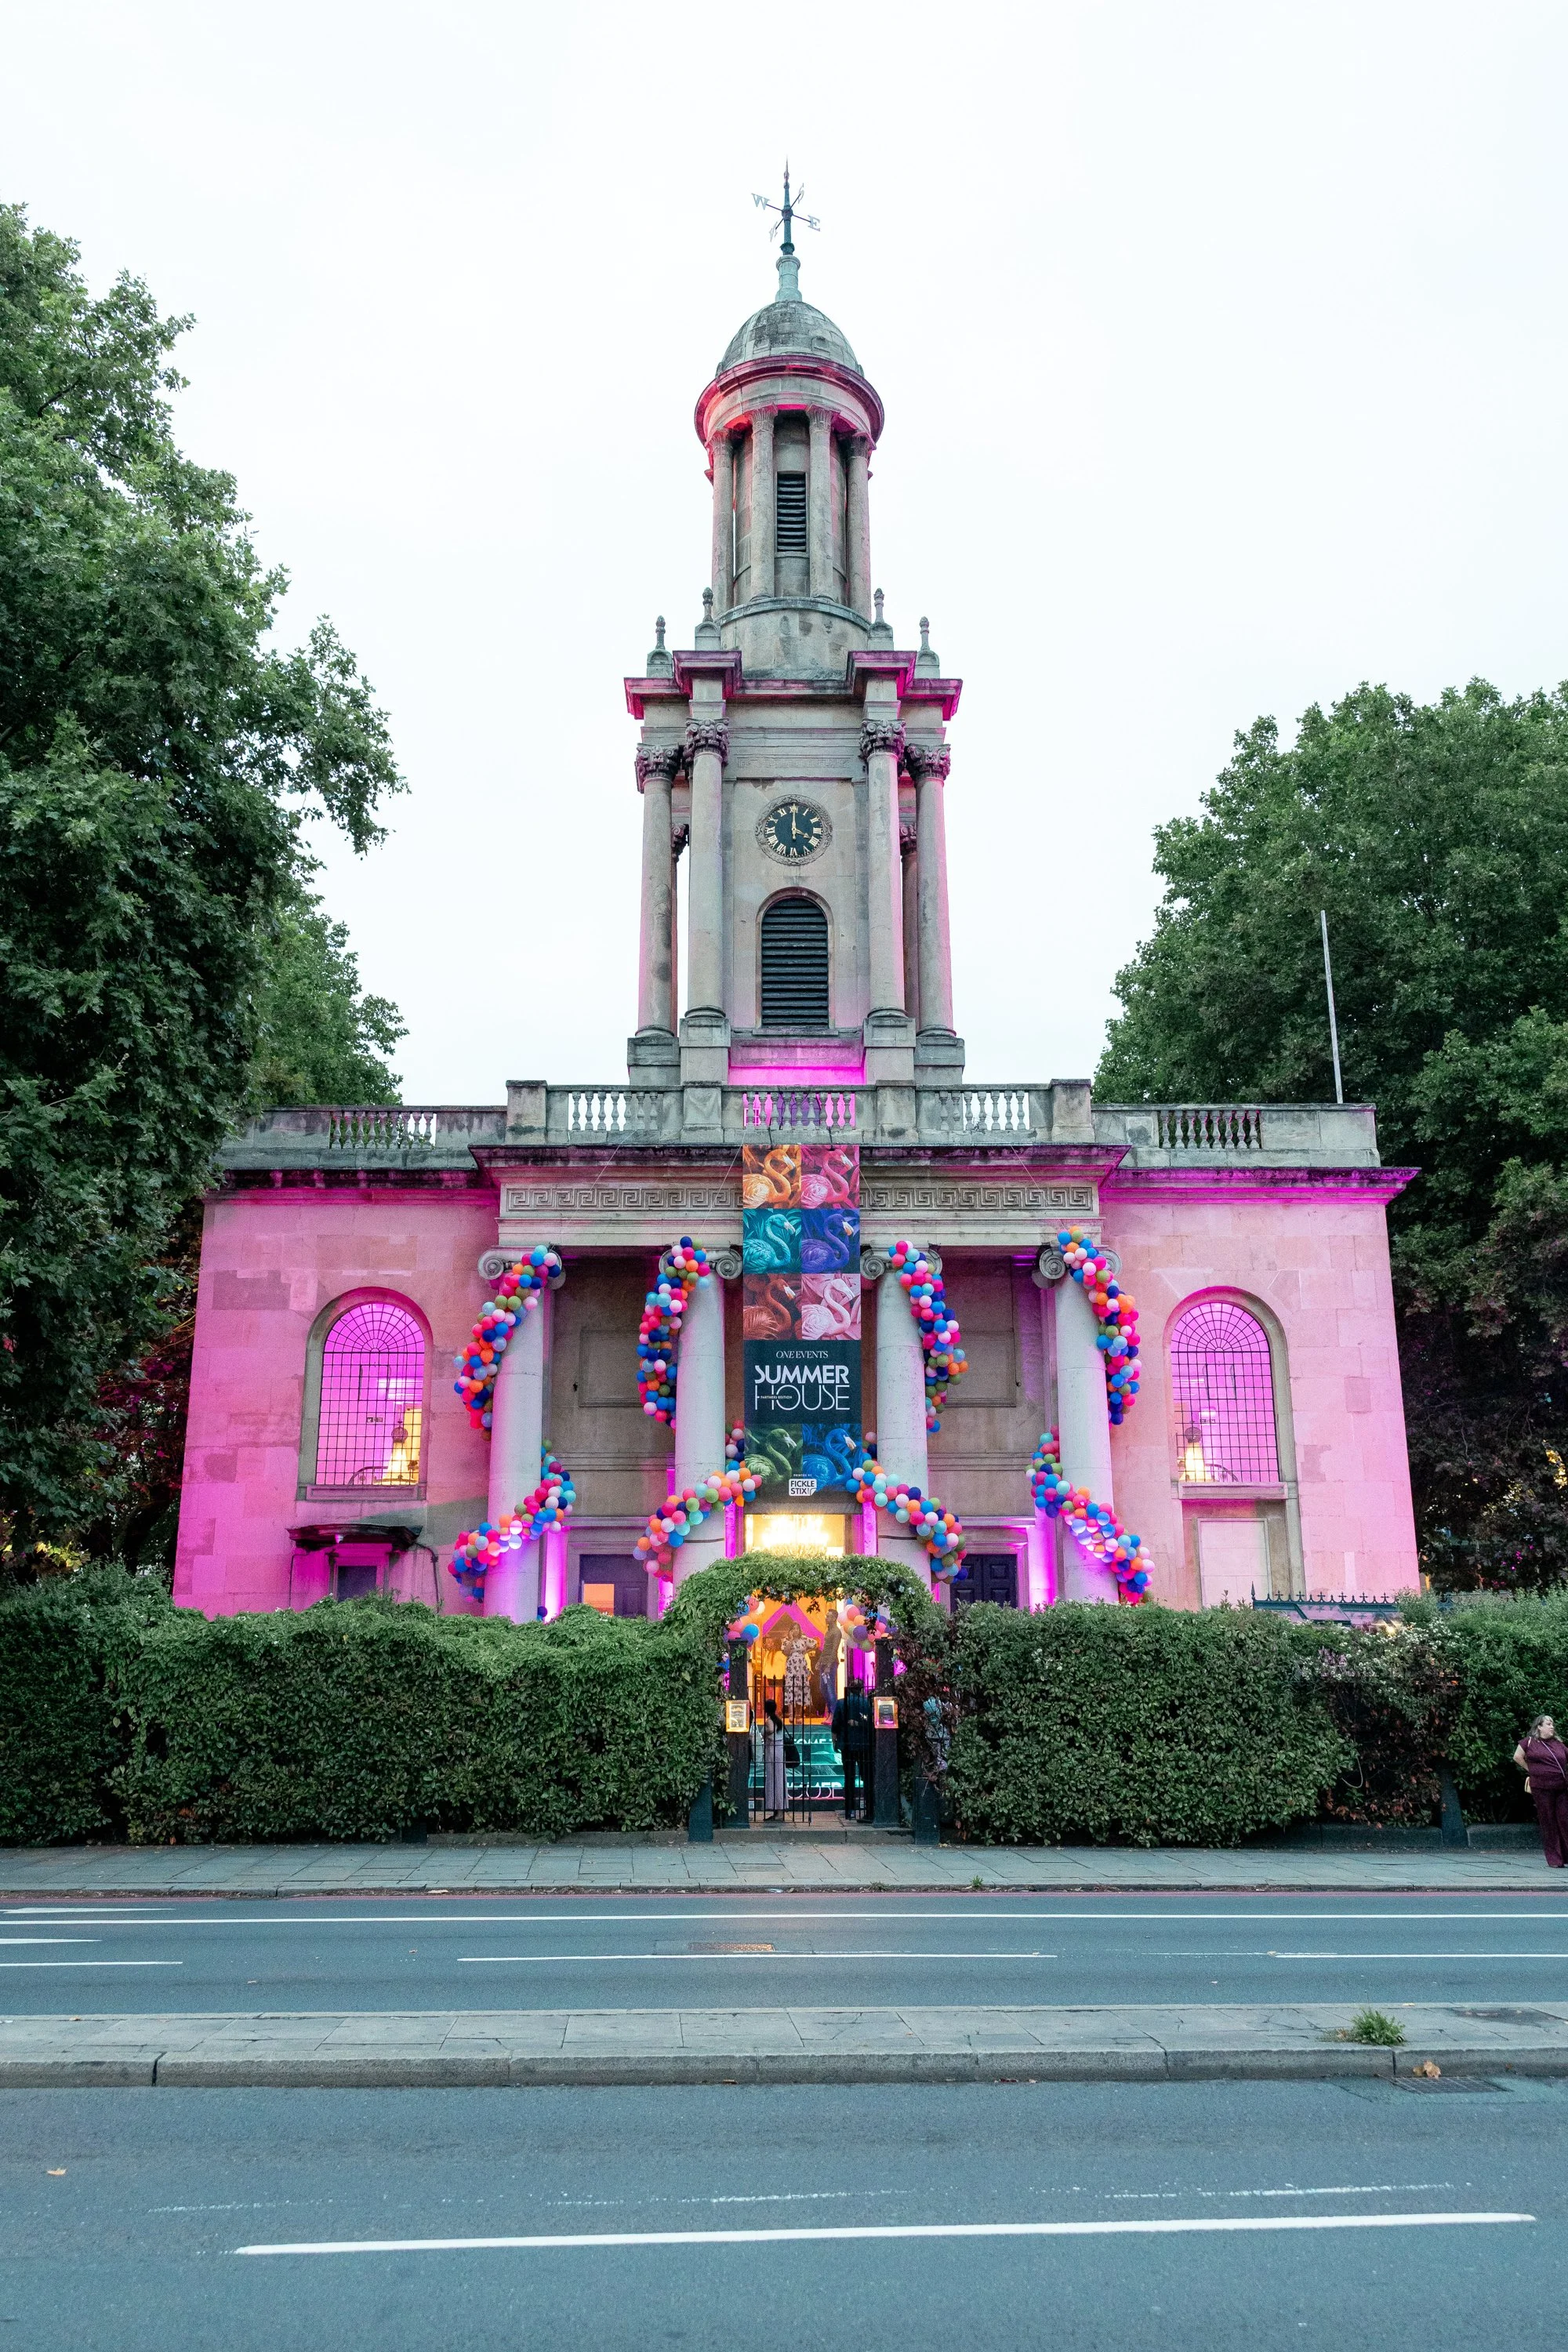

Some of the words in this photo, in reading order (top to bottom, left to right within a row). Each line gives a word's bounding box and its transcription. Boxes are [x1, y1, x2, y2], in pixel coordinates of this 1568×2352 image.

[751, 193, 770, 210] W
[808, 215, 821, 231] E
[775, 1350, 795, 1359] ONE
[796, 1350, 829, 1359] EVENTS
[754, 1365, 850, 1384] SUMMER
[754, 1385, 851, 1410] HOUSE
